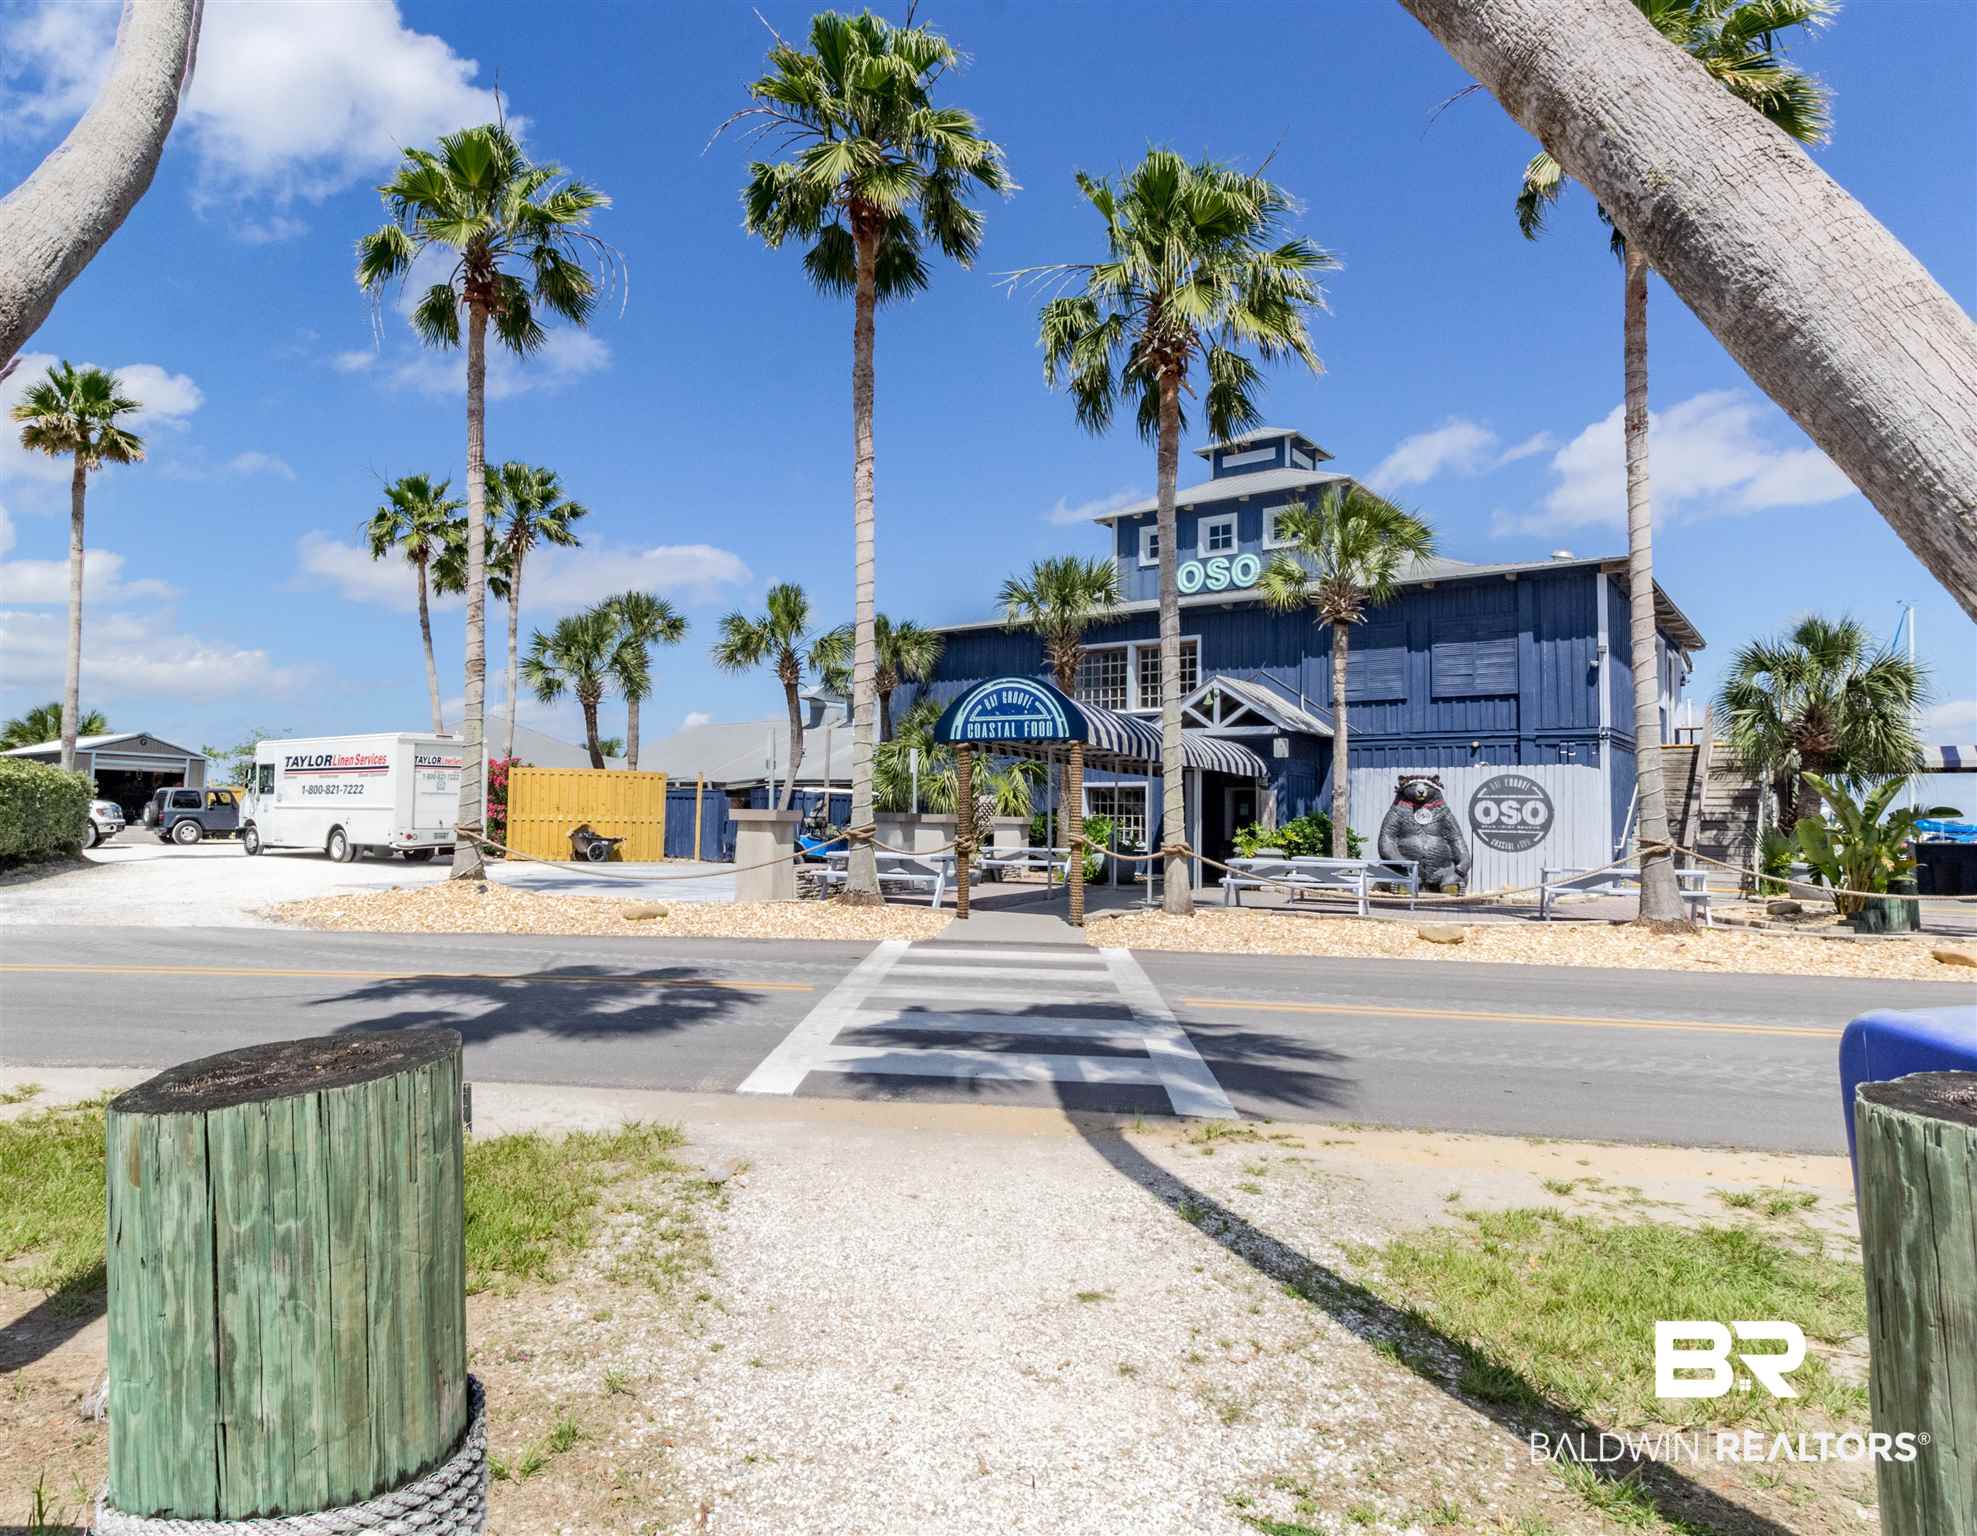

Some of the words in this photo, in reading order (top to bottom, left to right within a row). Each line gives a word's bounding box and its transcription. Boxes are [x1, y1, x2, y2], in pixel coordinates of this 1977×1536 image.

[1177, 553, 1261, 594] OSO
[967, 721, 1017, 738] COASTAL
[1024, 720, 1053, 737] FOOD
[285, 755, 333, 767] TAYLOR
[333, 754, 354, 766] Linen
[355, 753, 387, 766] Services
[415, 756, 442, 765] TAYLOR
[302, 784, 365, 795] 1-800-821-7222
[1474, 799, 1549, 825] OSO
